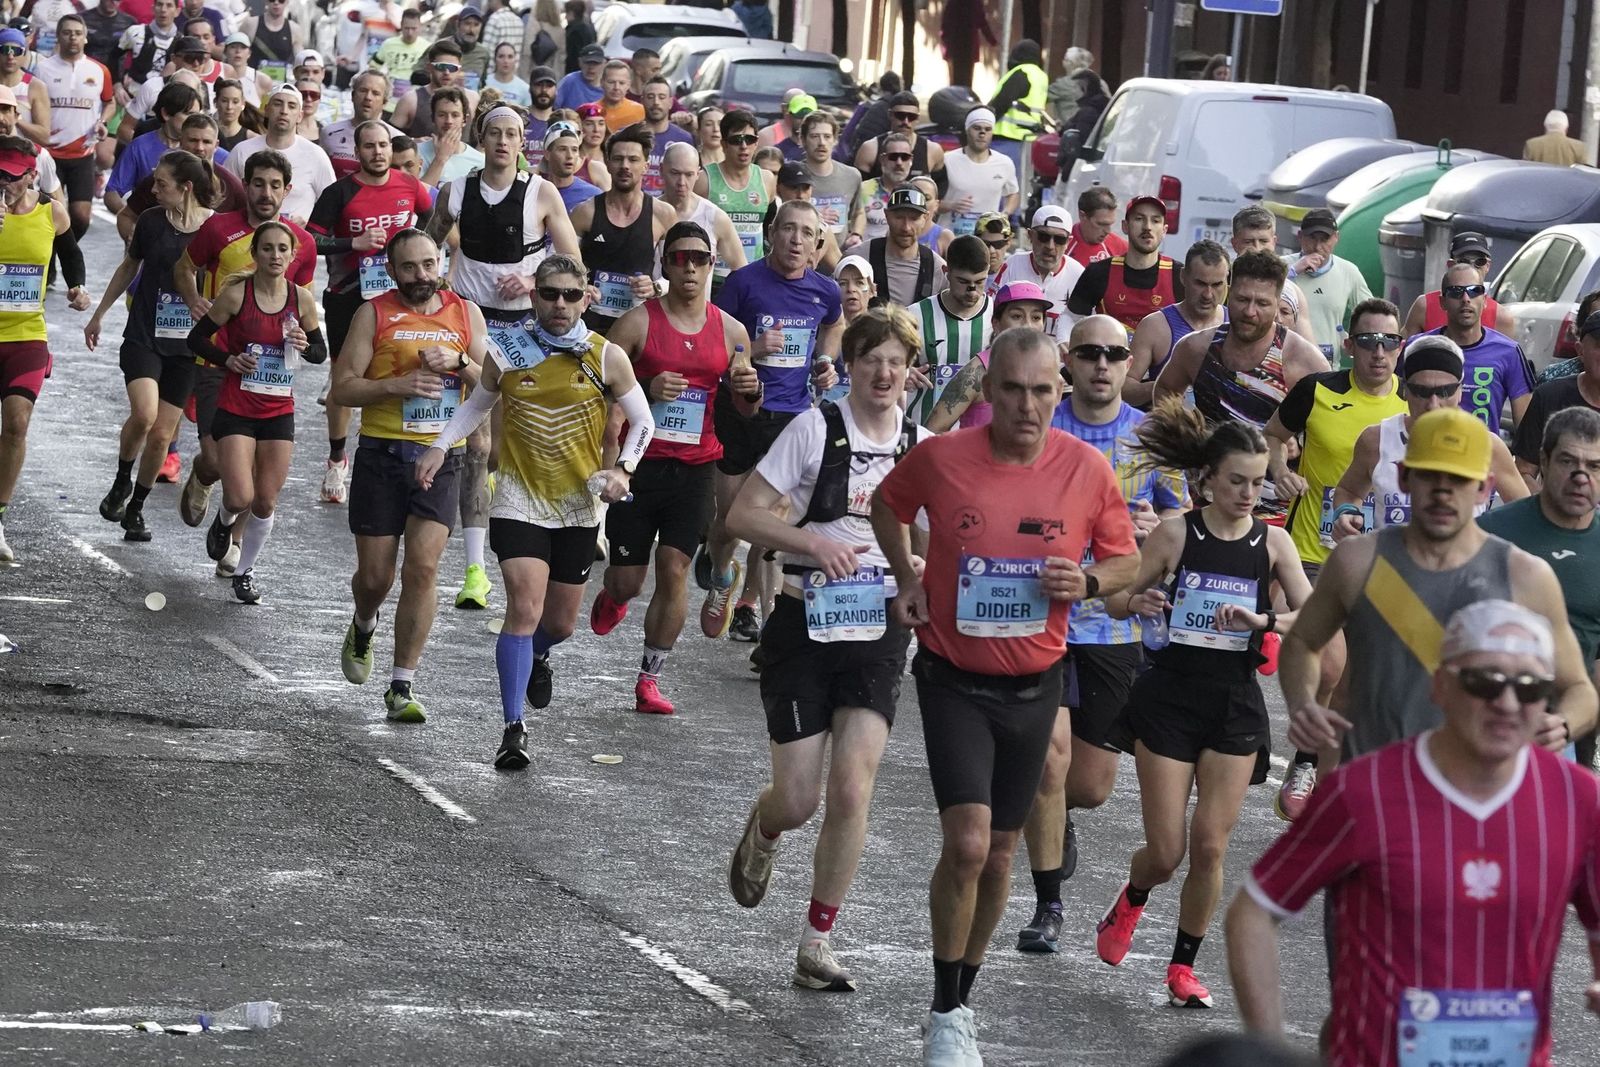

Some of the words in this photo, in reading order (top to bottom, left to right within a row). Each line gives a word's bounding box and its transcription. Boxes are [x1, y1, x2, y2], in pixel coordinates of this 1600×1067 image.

[10, 266, 38, 274] ZURICH
[365, 279, 397, 289] PERCU
[611, 276, 631, 284] ZURI
[0, 290, 39, 300] HAPOLIN
[606, 296, 633, 310] PRIET
[393, 329, 460, 344] ESPAÑA
[784, 334, 793, 342] 55
[677, 391, 702, 401] RICH
[411, 407, 440, 420] JUAN
[444, 407, 455, 418] PE
[667, 405, 685, 414] 8873
[660, 416, 688, 429] JEFF
[991, 563, 1040, 574] ZURICH
[1205, 578, 1249, 593] ZURICH
[991, 587, 1017, 598] 8521
[834, 594, 858, 605] 8802
[1203, 600, 1230, 610] 574
[976, 602, 1031, 619] DIDIER
[808, 609, 886, 627] ALEXANDRE
[1184, 612, 1216, 630] SOP
[1446, 998, 1521, 1017] ZURICH
